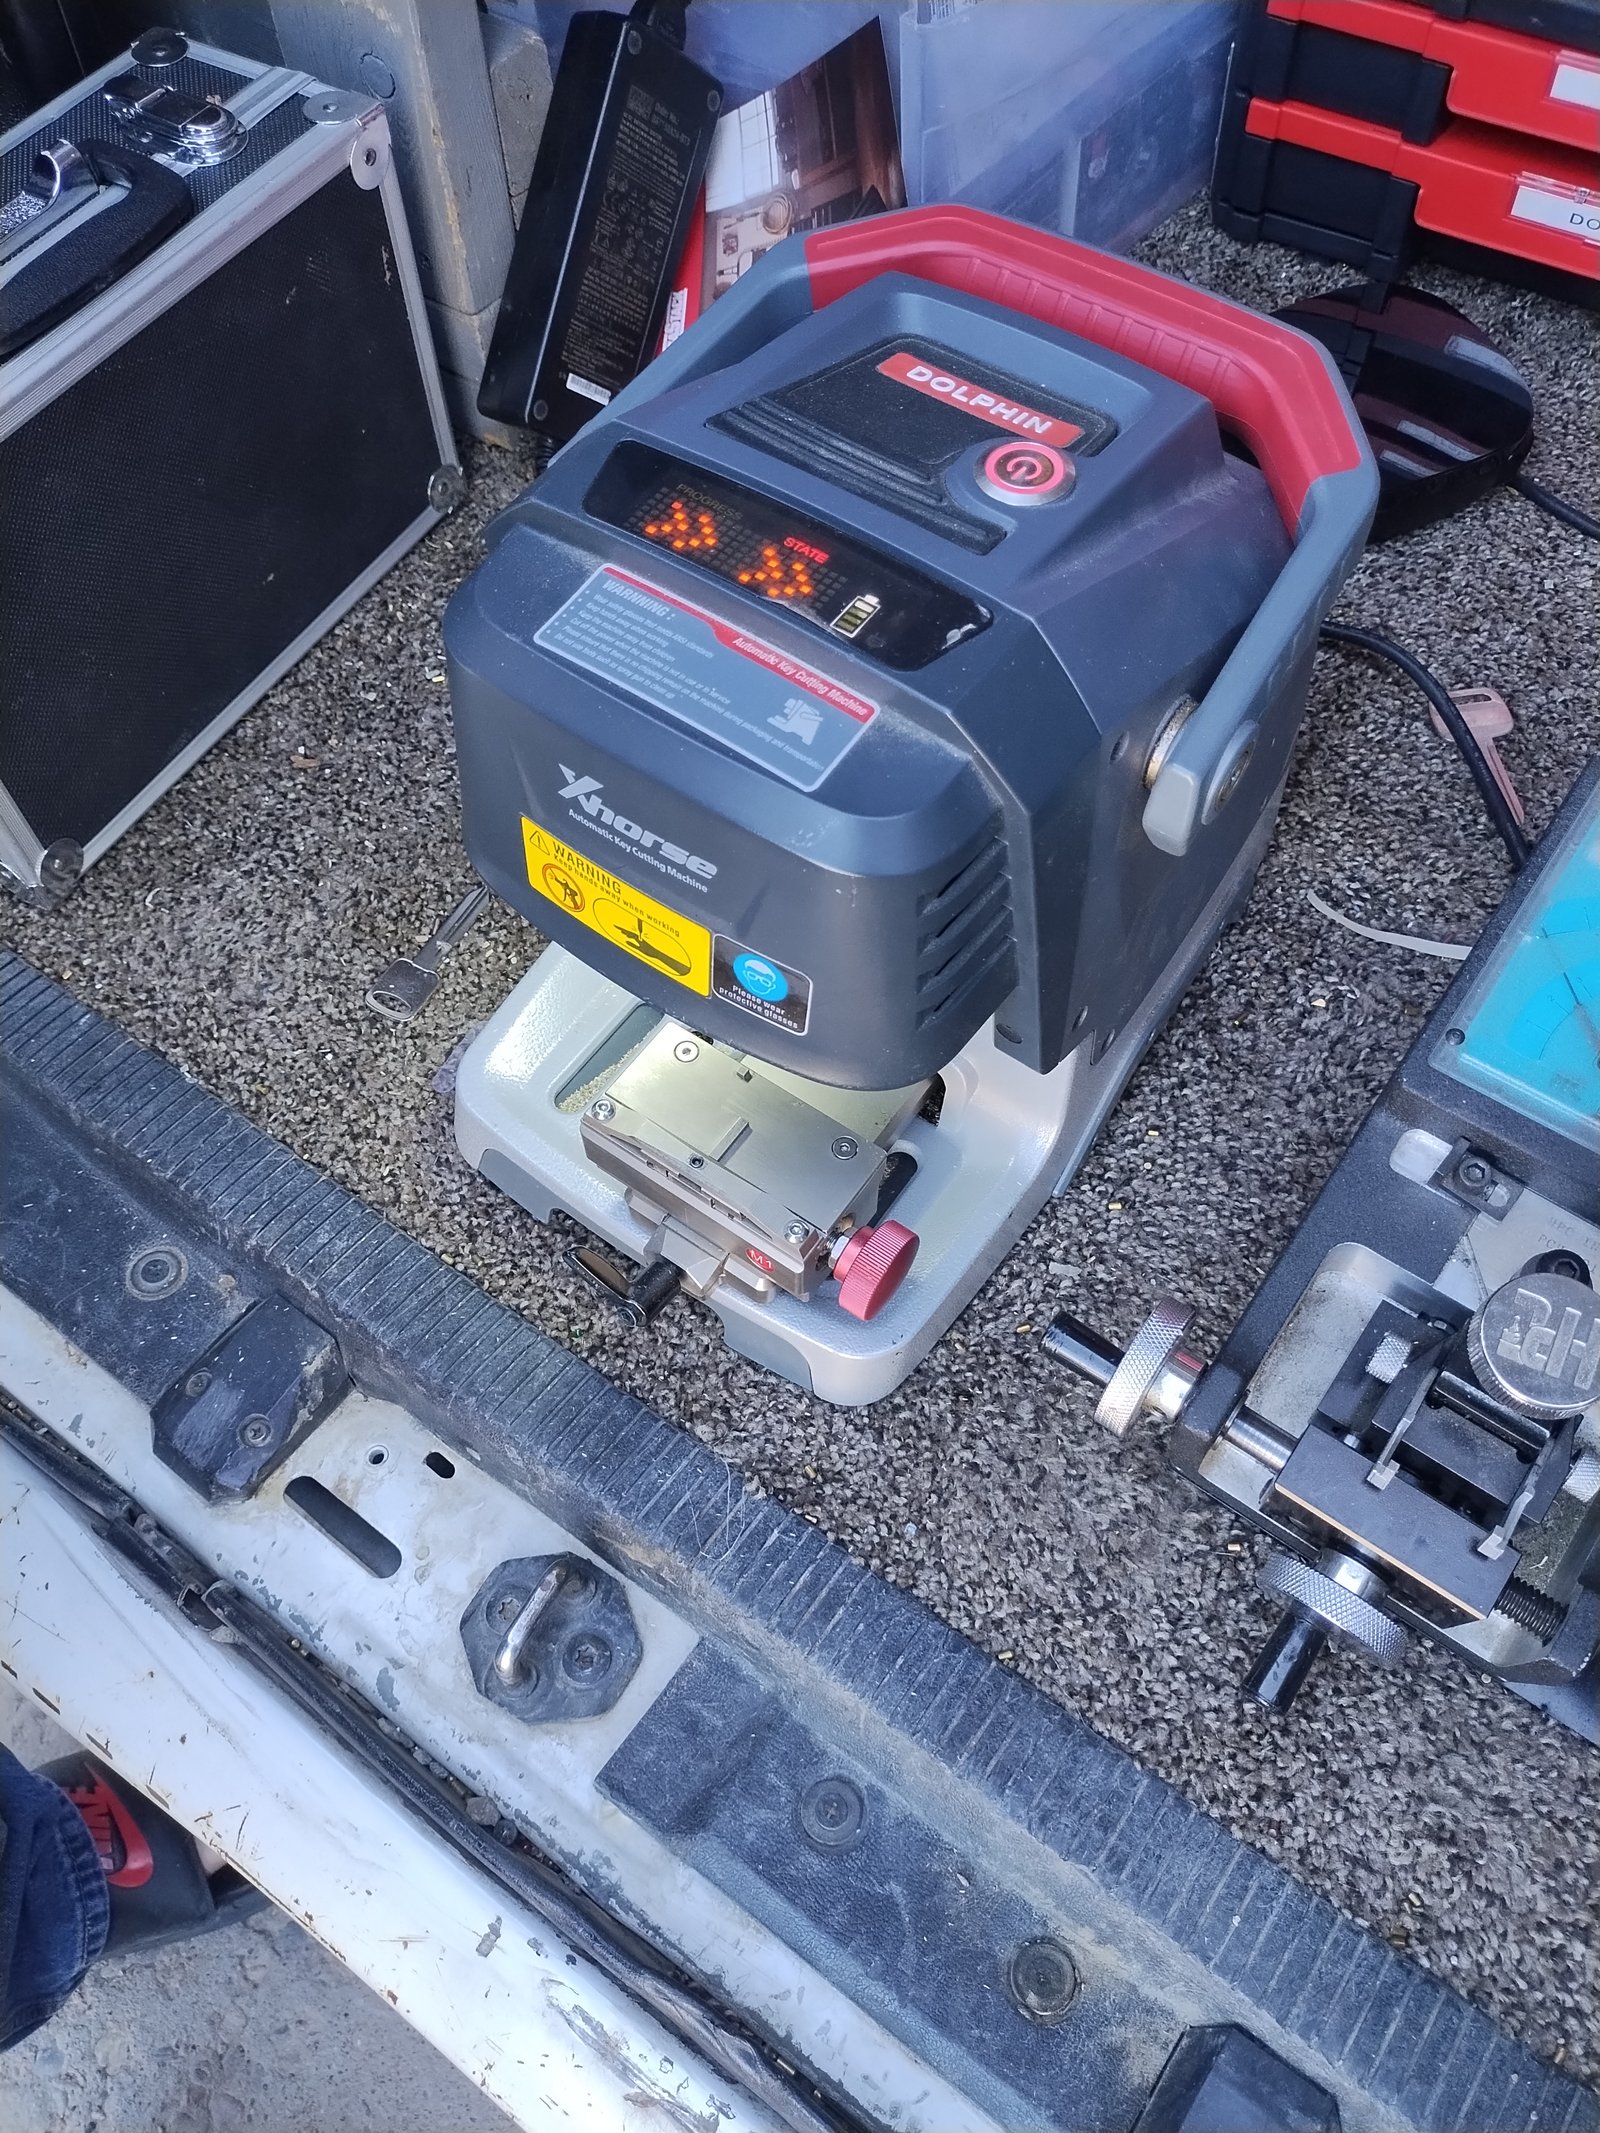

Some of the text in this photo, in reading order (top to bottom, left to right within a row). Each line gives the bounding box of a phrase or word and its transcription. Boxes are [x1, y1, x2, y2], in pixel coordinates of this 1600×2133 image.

[906, 365, 1053, 434] DOLPHIN
[676, 484, 743, 521] PROGRESS
[783, 537, 830, 564] STATE
[733, 638, 868, 715] Automatic Key Cutting Machine
[558, 763, 718, 880] Xhorse
[552, 841, 622, 895] WARNING
[569, 809, 708, 894] Automatic Key Cutting Machine
[553, 853, 680, 937] Keep hands away when working
[718, 986, 799, 1030] protective glasses
[731, 984, 786, 1016] Please wear
[750, 1249, 772, 1269] M1
